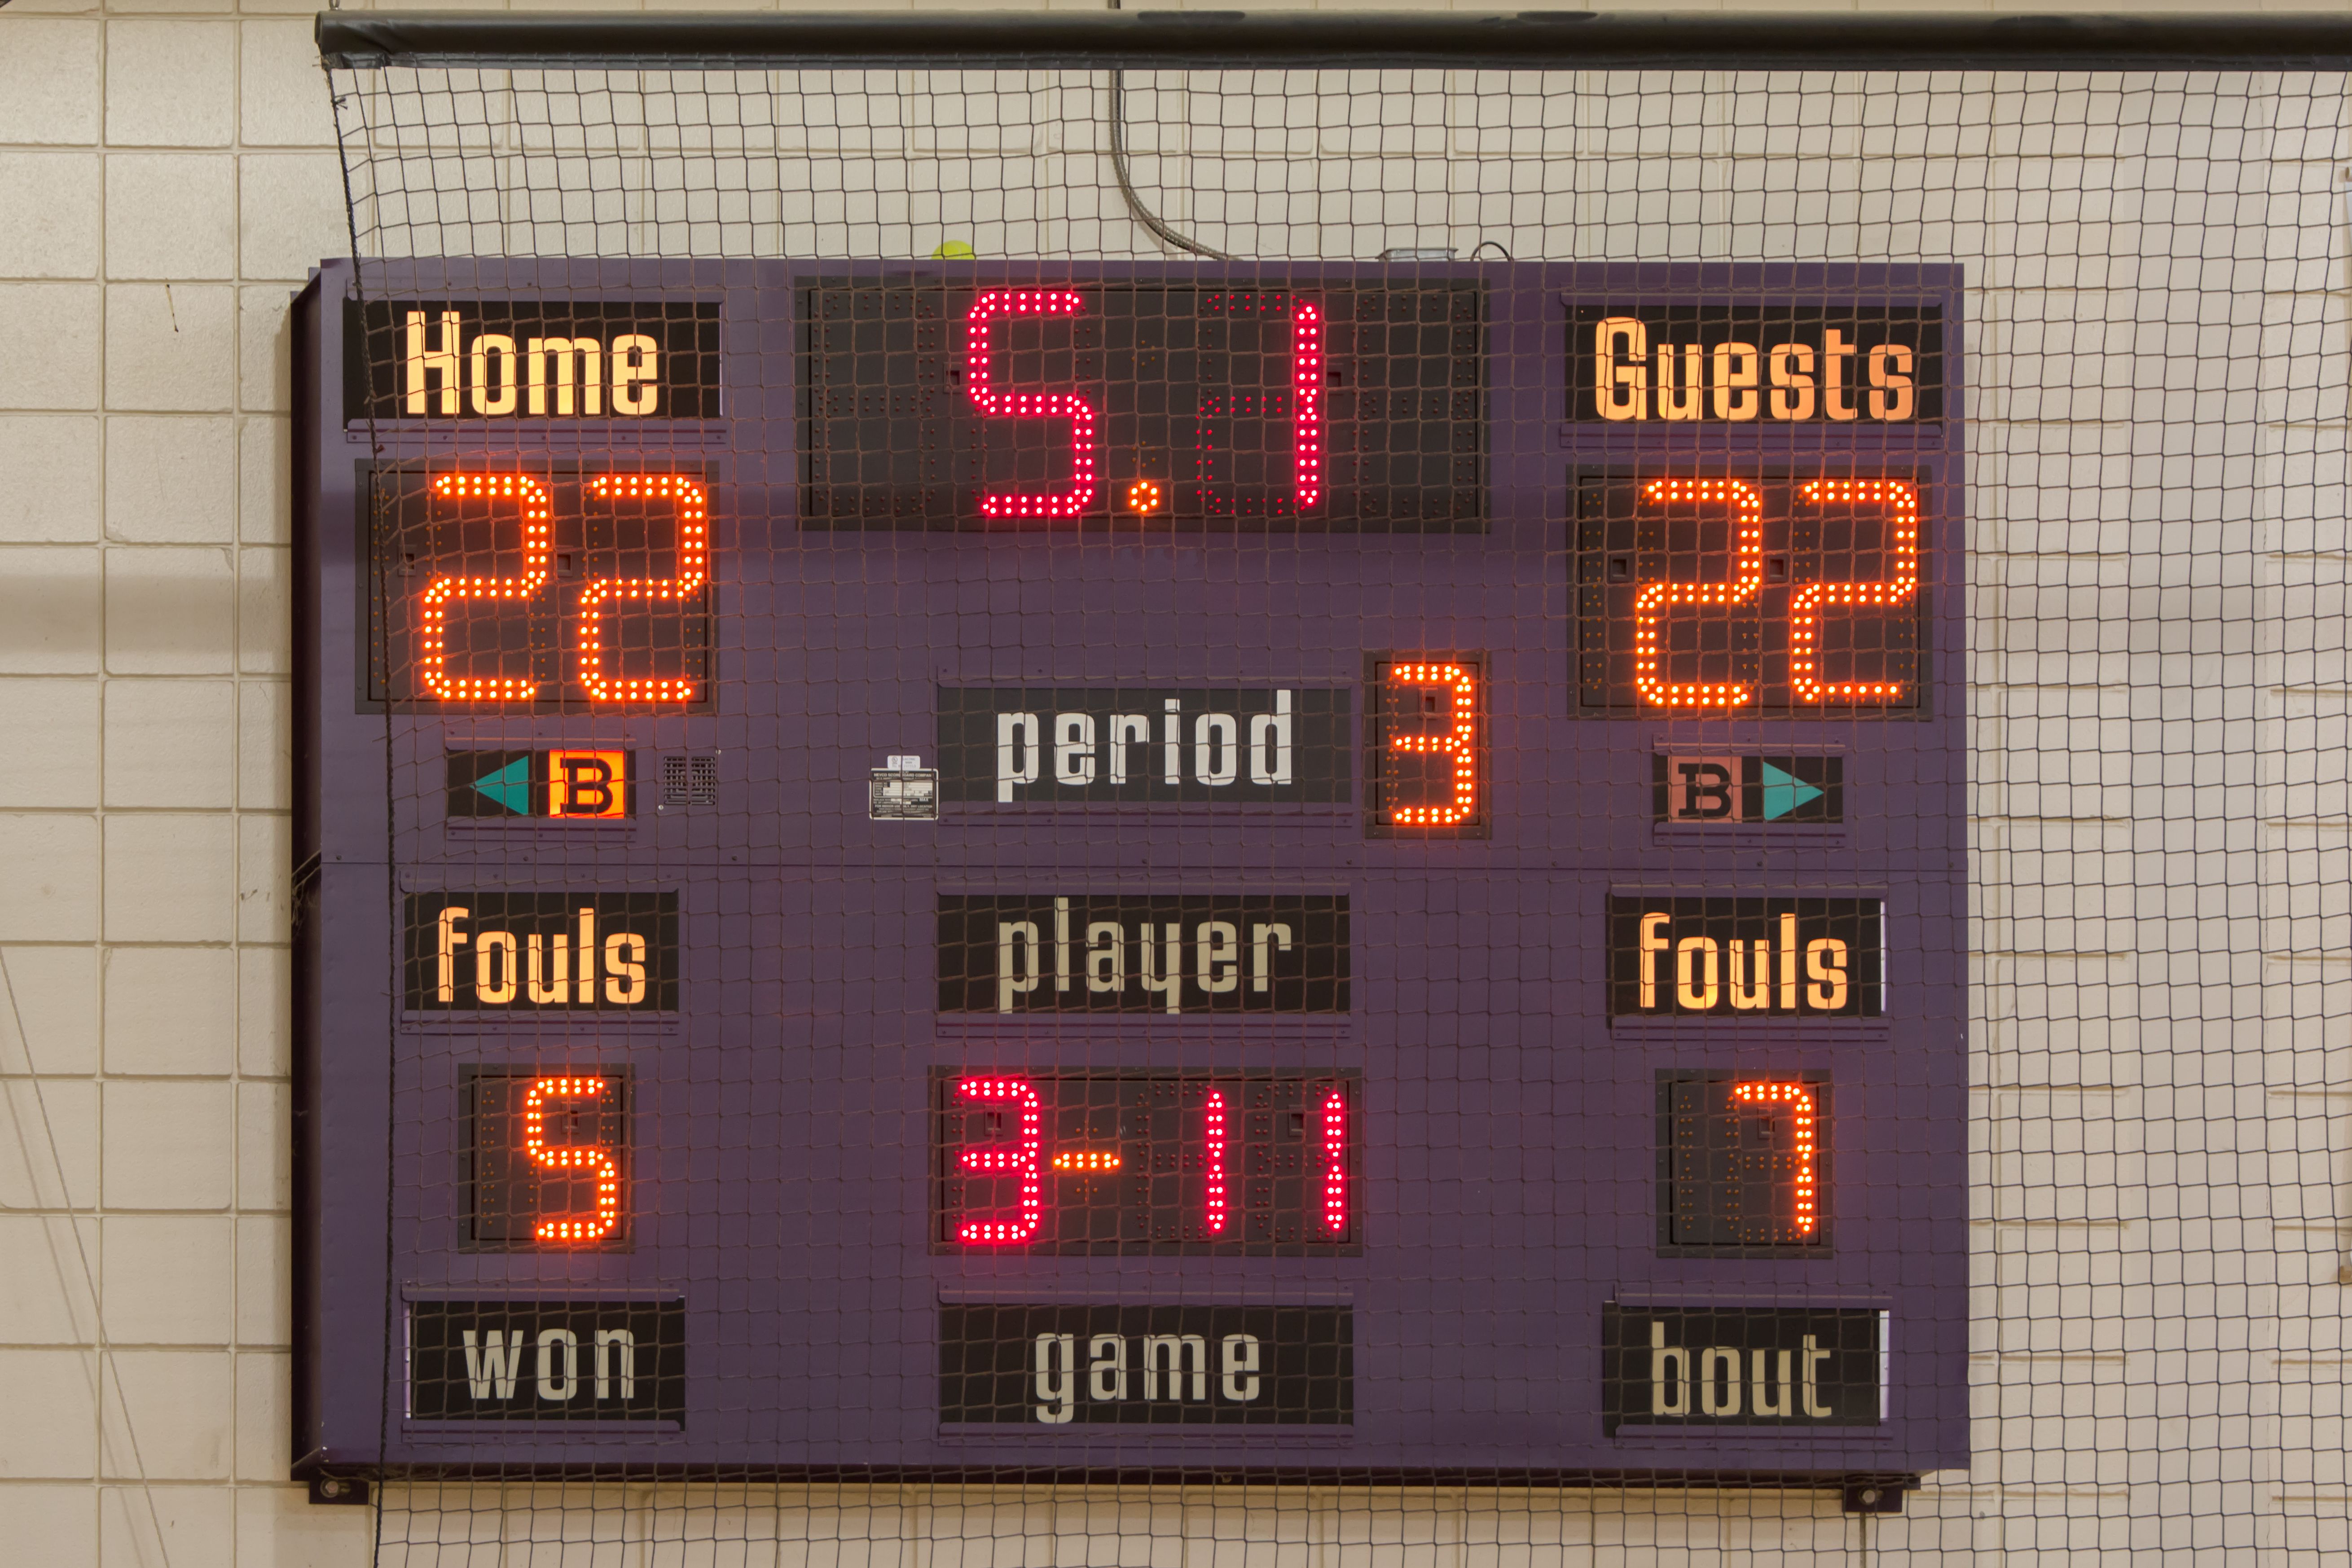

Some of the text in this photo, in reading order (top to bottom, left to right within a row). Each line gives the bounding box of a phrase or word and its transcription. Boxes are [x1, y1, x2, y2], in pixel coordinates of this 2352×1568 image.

[407, 312, 657, 415] Home
[1596, 317, 1912, 420] Guests
[421, 470, 706, 704] 22
[1635, 478, 1920, 710] 22
[560, 757, 613, 813] B
[998, 690, 1291, 802] period
[1391, 661, 1475, 827] 3
[1678, 763, 1731, 819] B
[439, 907, 645, 1004] fouls
[1000, 898, 1291, 1014] player
[1640, 912, 1846, 1009] fouls
[523, 1074, 618, 1244] 5
[1734, 1081, 1816, 1234] 7
[464, 1330, 633, 1401] won
[1036, 1333, 1258, 1423] game
[1653, 1323, 1831, 1417] bout
